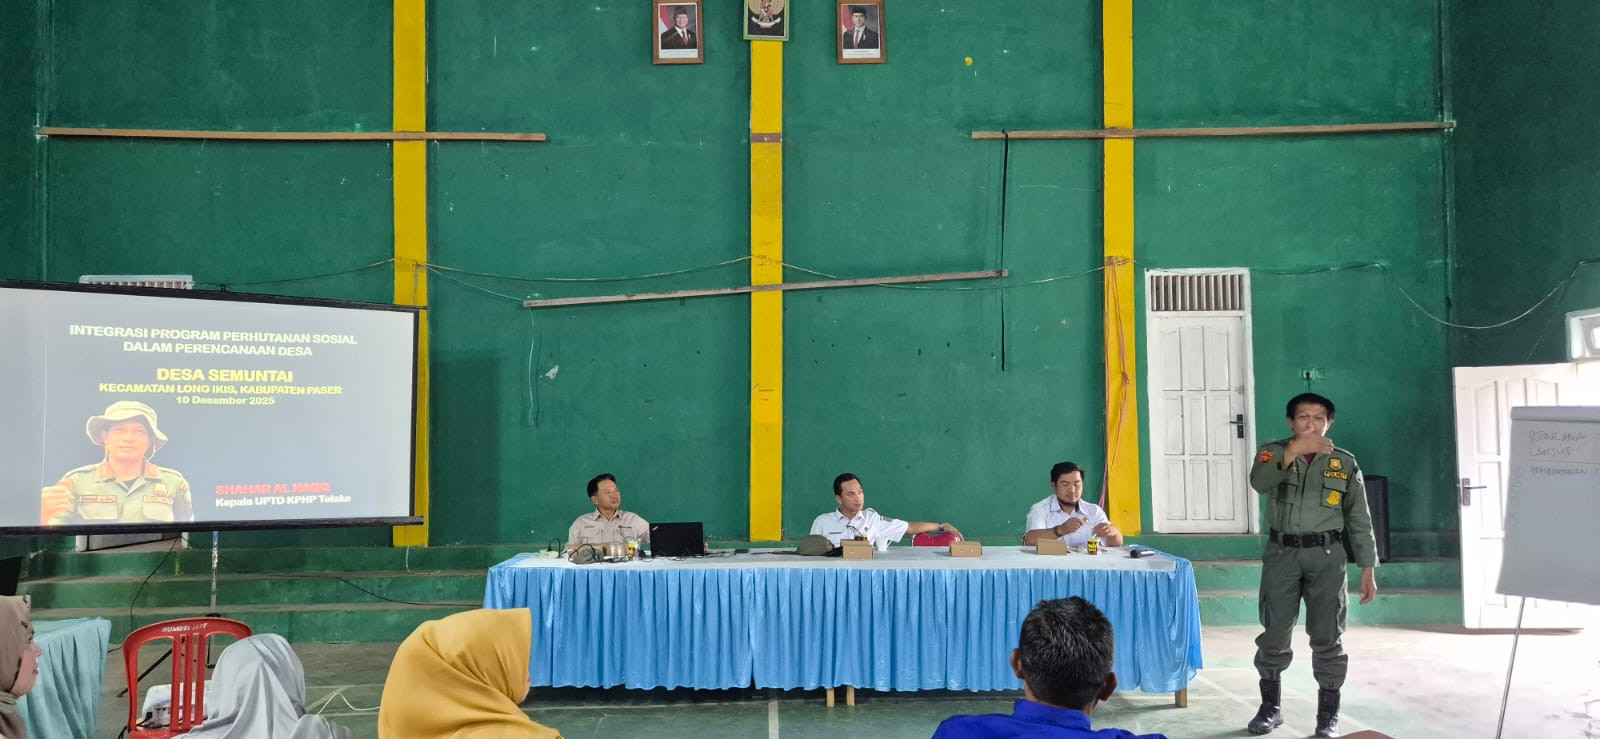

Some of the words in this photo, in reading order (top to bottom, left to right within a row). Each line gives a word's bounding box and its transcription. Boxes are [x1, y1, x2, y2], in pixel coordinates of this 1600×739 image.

[70, 325, 148, 338] INTEGRASI
[151, 329, 220, 340] PROGRAM
[223, 331, 311, 343] PERHUTANAN
[313, 334, 358, 344] SOSIAL
[123, 341, 173, 352] DALAM
[176, 343, 276, 355] PERENCANAAN
[278, 346, 313, 356] DESA
[157, 368, 205, 381] DESA
[208, 369, 293, 383] SEMUNTAI
[99, 383, 175, 393] KECAMATAN
[177, 384, 210, 394] LONG
[212, 385, 238, 395] IKIS,
[240, 385, 305, 395] KABUPATEN
[307, 386, 342, 395] PASER
[176, 396, 190, 404] 10
[192, 396, 247, 405] Desember
[249, 396, 276, 405] 2025
[216, 484, 271, 495] SHAHAR
[273, 484, 290, 494] AL
[216, 497, 253, 508] Kepala
[255, 496, 284, 506] UPTD
[287, 495, 317, 505] KPHP
